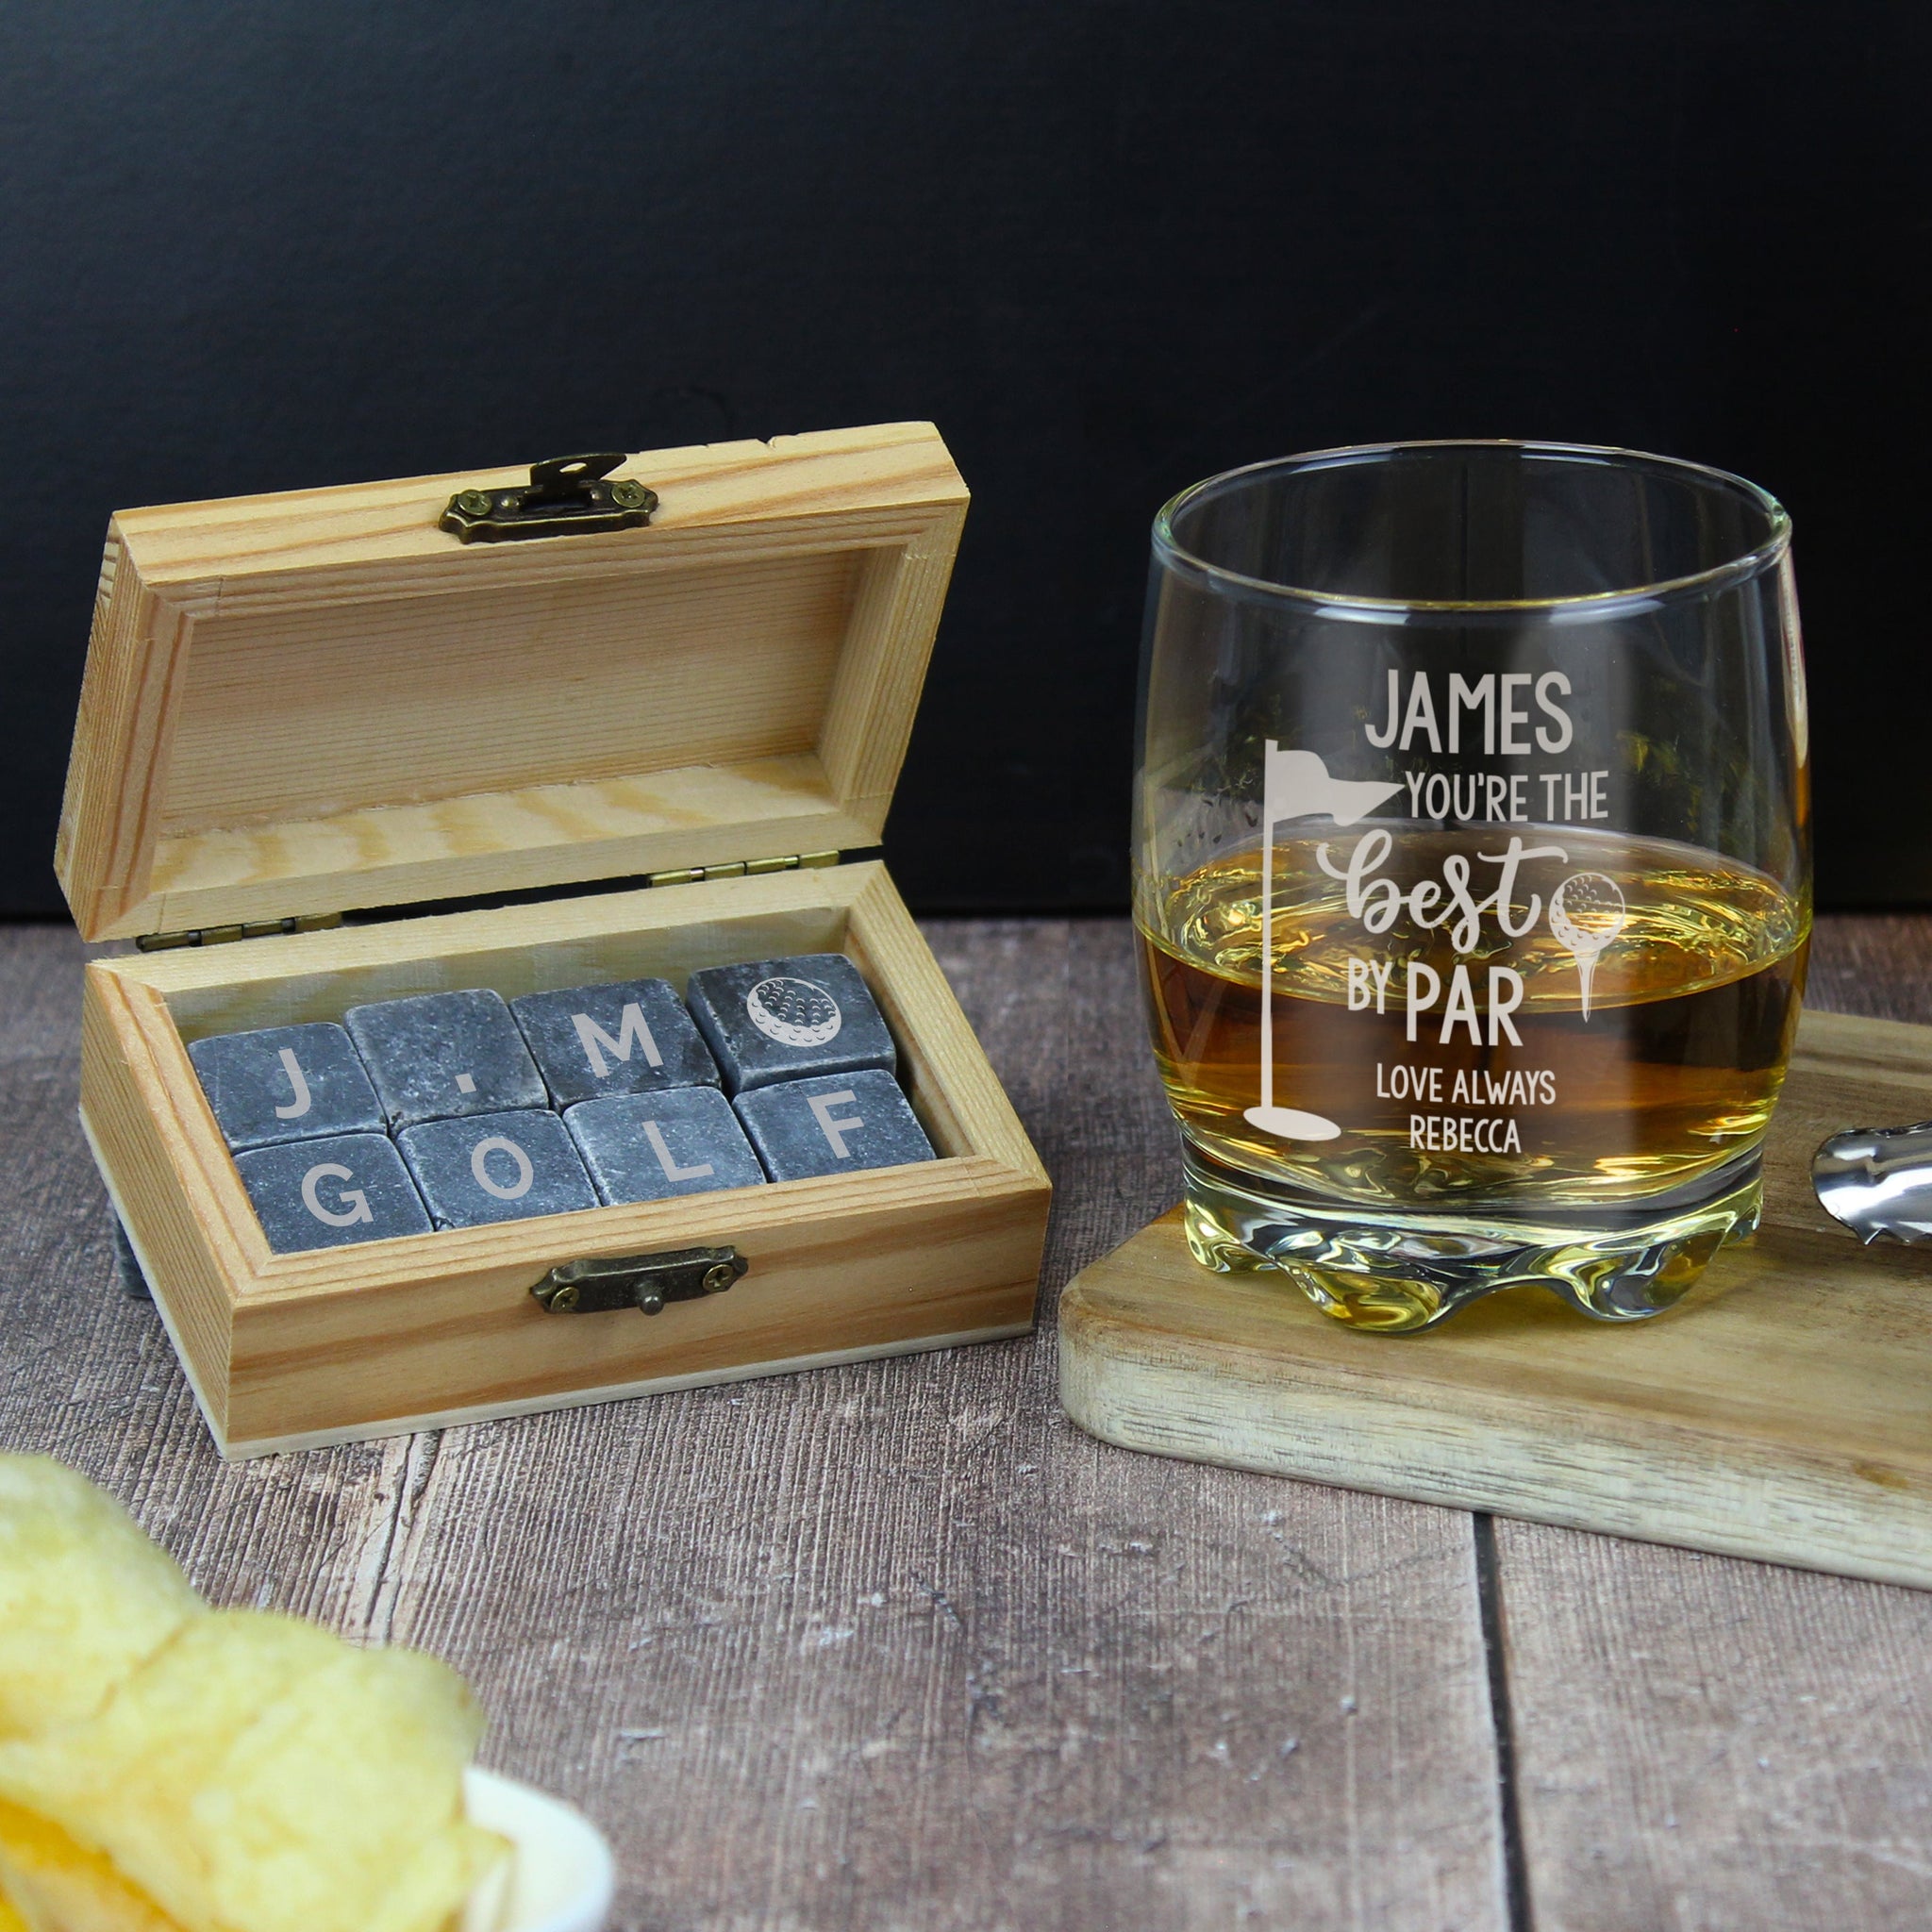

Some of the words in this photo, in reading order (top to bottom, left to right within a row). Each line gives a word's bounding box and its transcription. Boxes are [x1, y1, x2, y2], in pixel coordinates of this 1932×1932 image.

[1364, 669, 1573, 755] JAMES
[1405, 771, 1528, 822] YOU'RE
[1540, 771, 1608, 821] THE
[1316, 828, 1569, 954] best
[1347, 958, 1391, 1014] BY
[1406, 962, 1524, 1046] PAR
[1376, 1063, 1443, 1102] LOVE
[1451, 1069, 1557, 1105] ALWAYS
[1409, 1114, 1522, 1154] REBECCA
